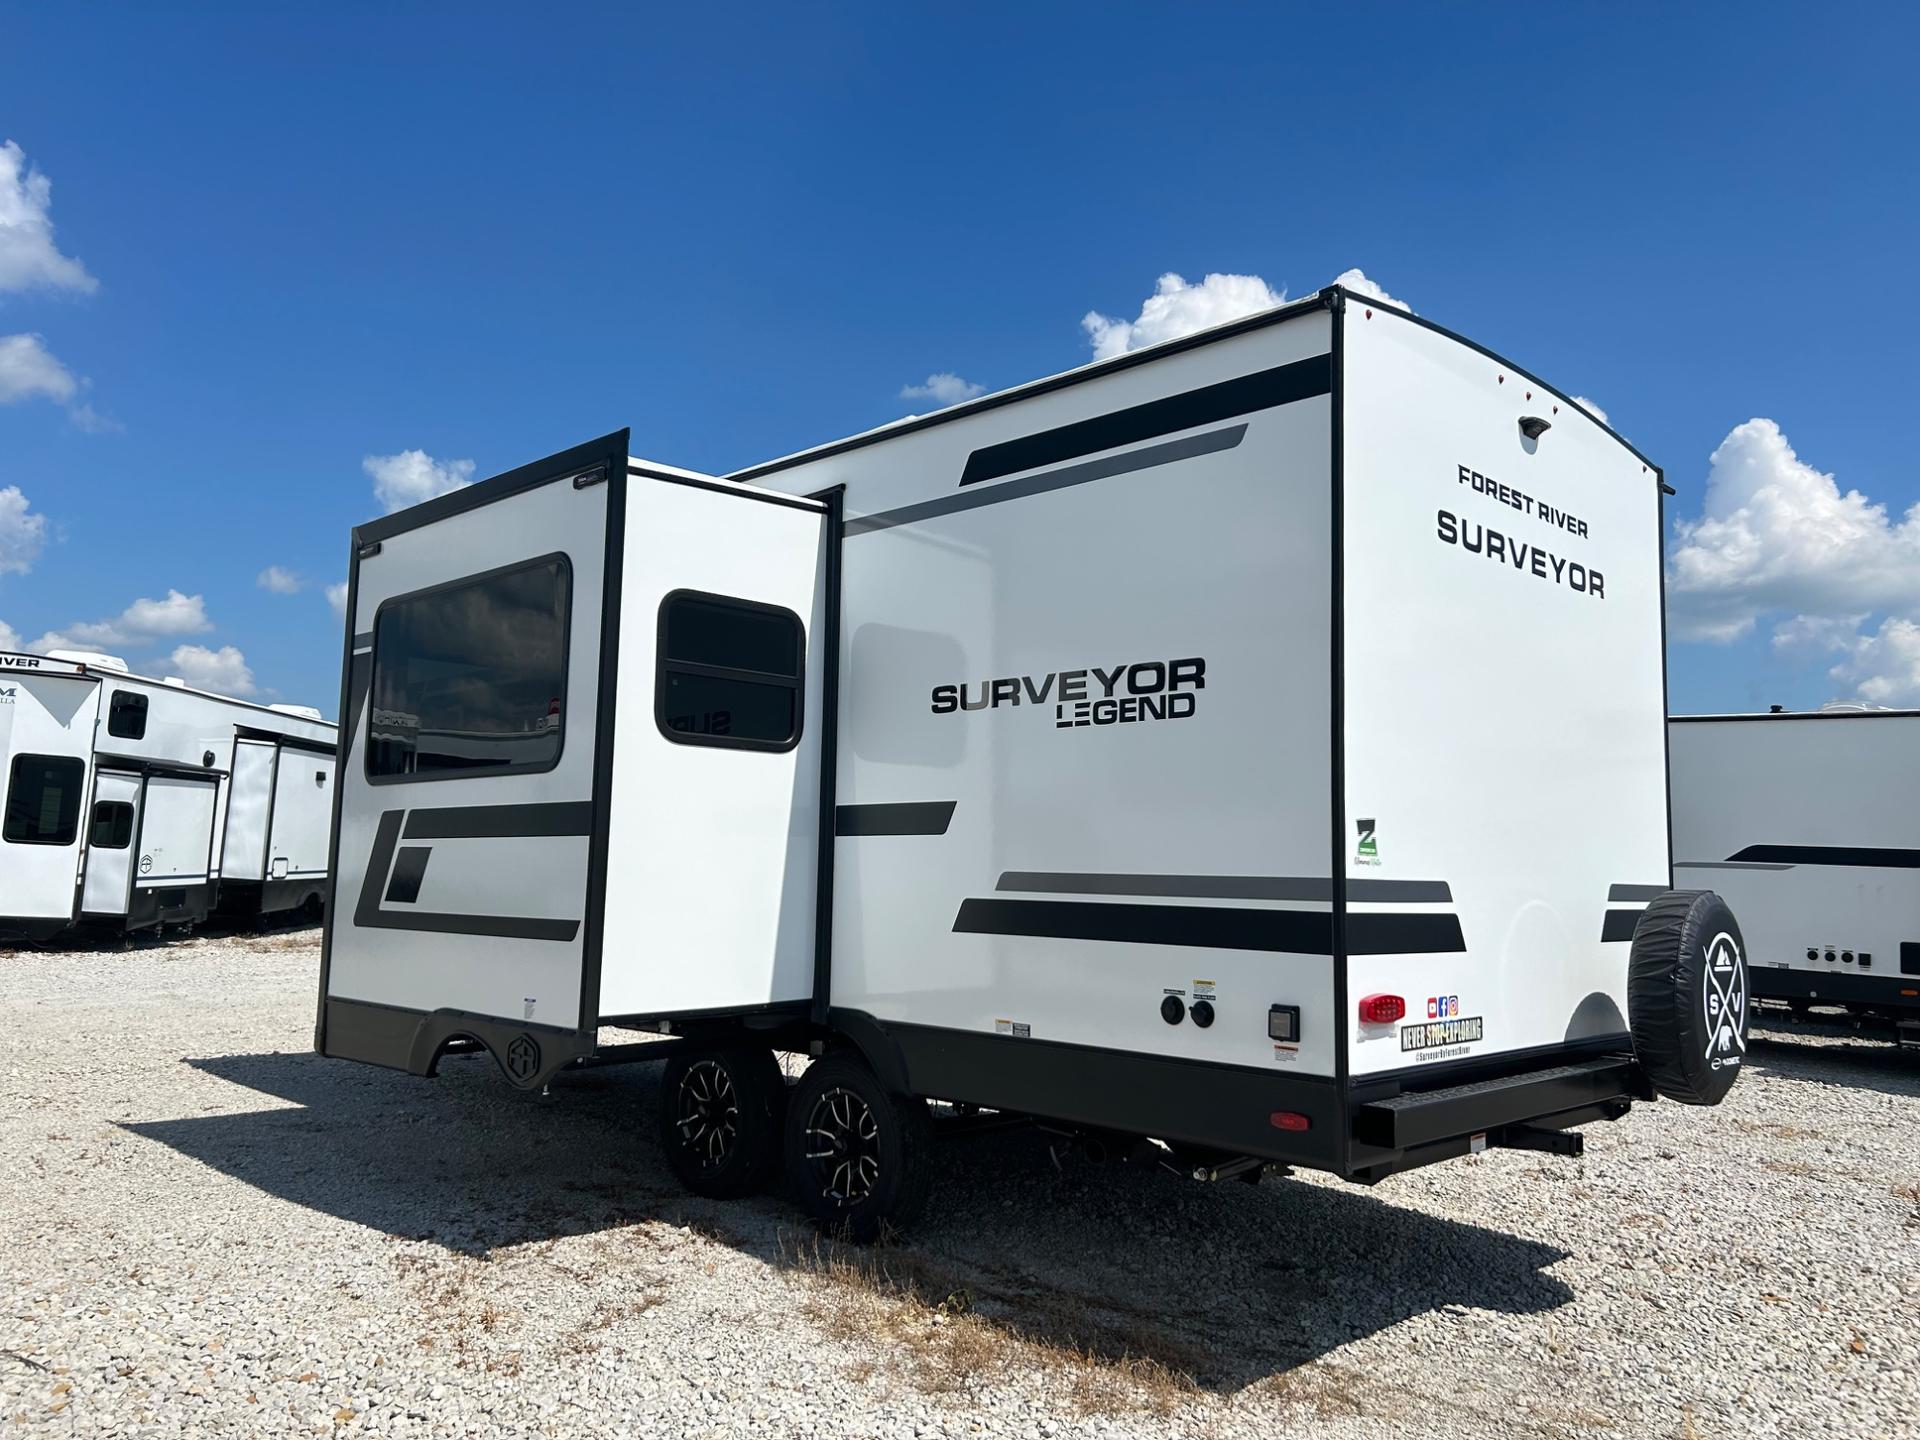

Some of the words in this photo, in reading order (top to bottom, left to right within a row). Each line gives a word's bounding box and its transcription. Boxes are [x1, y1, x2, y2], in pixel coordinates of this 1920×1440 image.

[1458, 464, 1534, 514] FOREST
[1538, 501, 1588, 539] RIVER
[1437, 509, 1605, 600] SURVEYOR
[931, 657, 1206, 714] SURVEYOR
[1056, 692, 1195, 728] LEGEND
[1402, 1026, 1425, 1050] NEVER
[1426, 1023, 1445, 1046] STOP
[1445, 1018, 1481, 1043] EXPLORING
